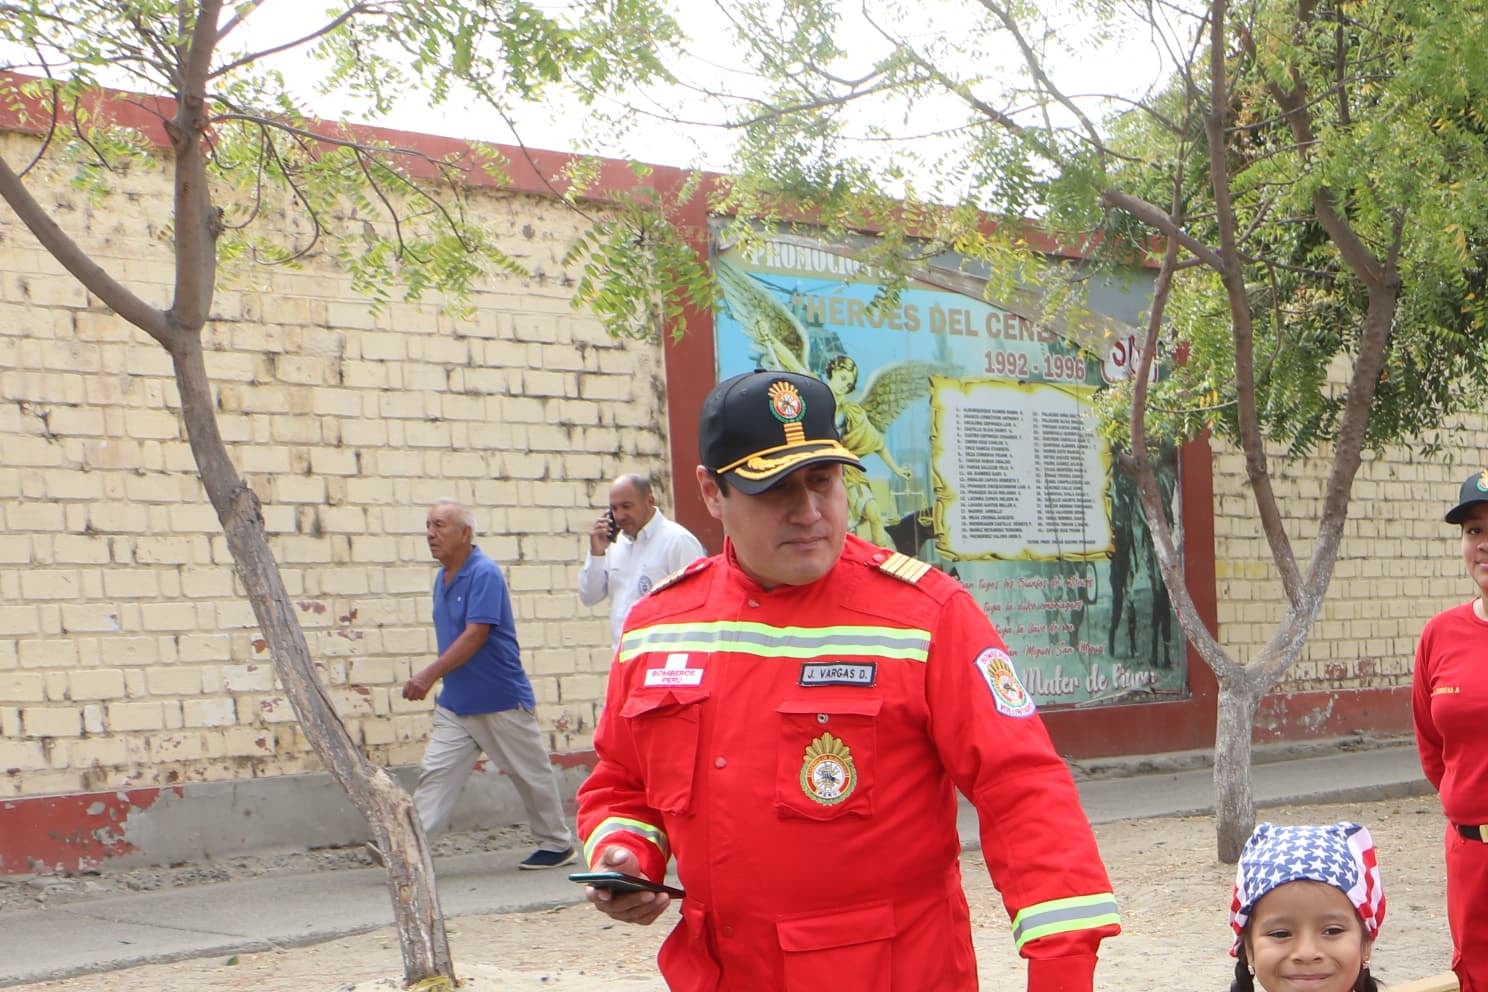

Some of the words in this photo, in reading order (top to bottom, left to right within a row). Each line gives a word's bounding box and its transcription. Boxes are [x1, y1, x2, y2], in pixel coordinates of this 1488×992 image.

[929, 305, 978, 337] DEL
[984, 350, 1029, 377] 1992
[1044, 354, 1086, 381] 1996
[651, 670, 696, 678] BOMBEROS
[820, 668, 855, 679] VARGAS
[1024, 665, 1080, 697] Mater
[1087, 664, 1108, 693] de
